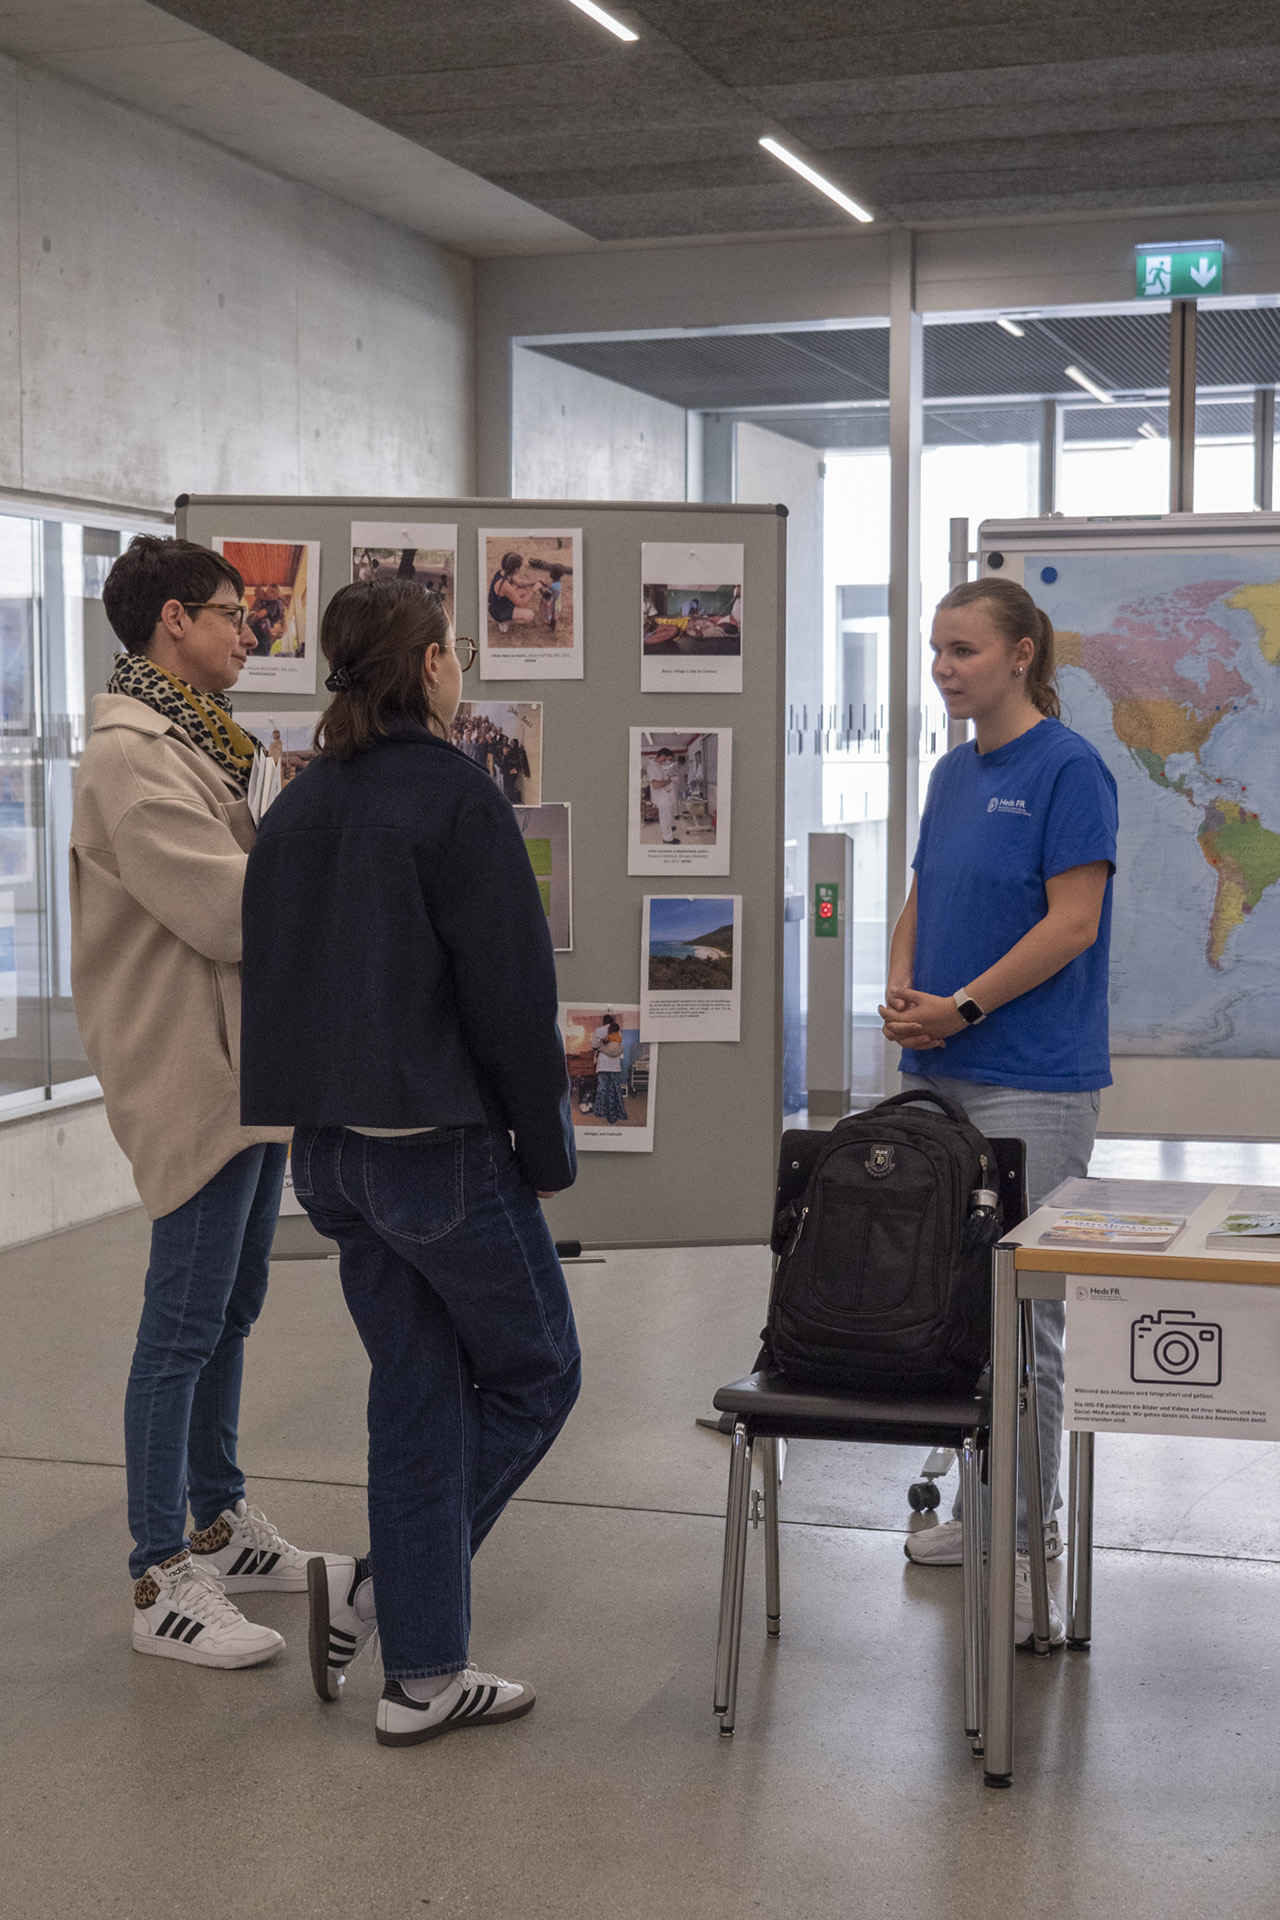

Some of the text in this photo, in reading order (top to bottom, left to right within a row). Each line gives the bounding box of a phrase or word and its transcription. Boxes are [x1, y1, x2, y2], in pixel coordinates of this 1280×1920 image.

[1016, 800, 1026, 808] FR
[1090, 1287, 1120, 1296] Heds FR
